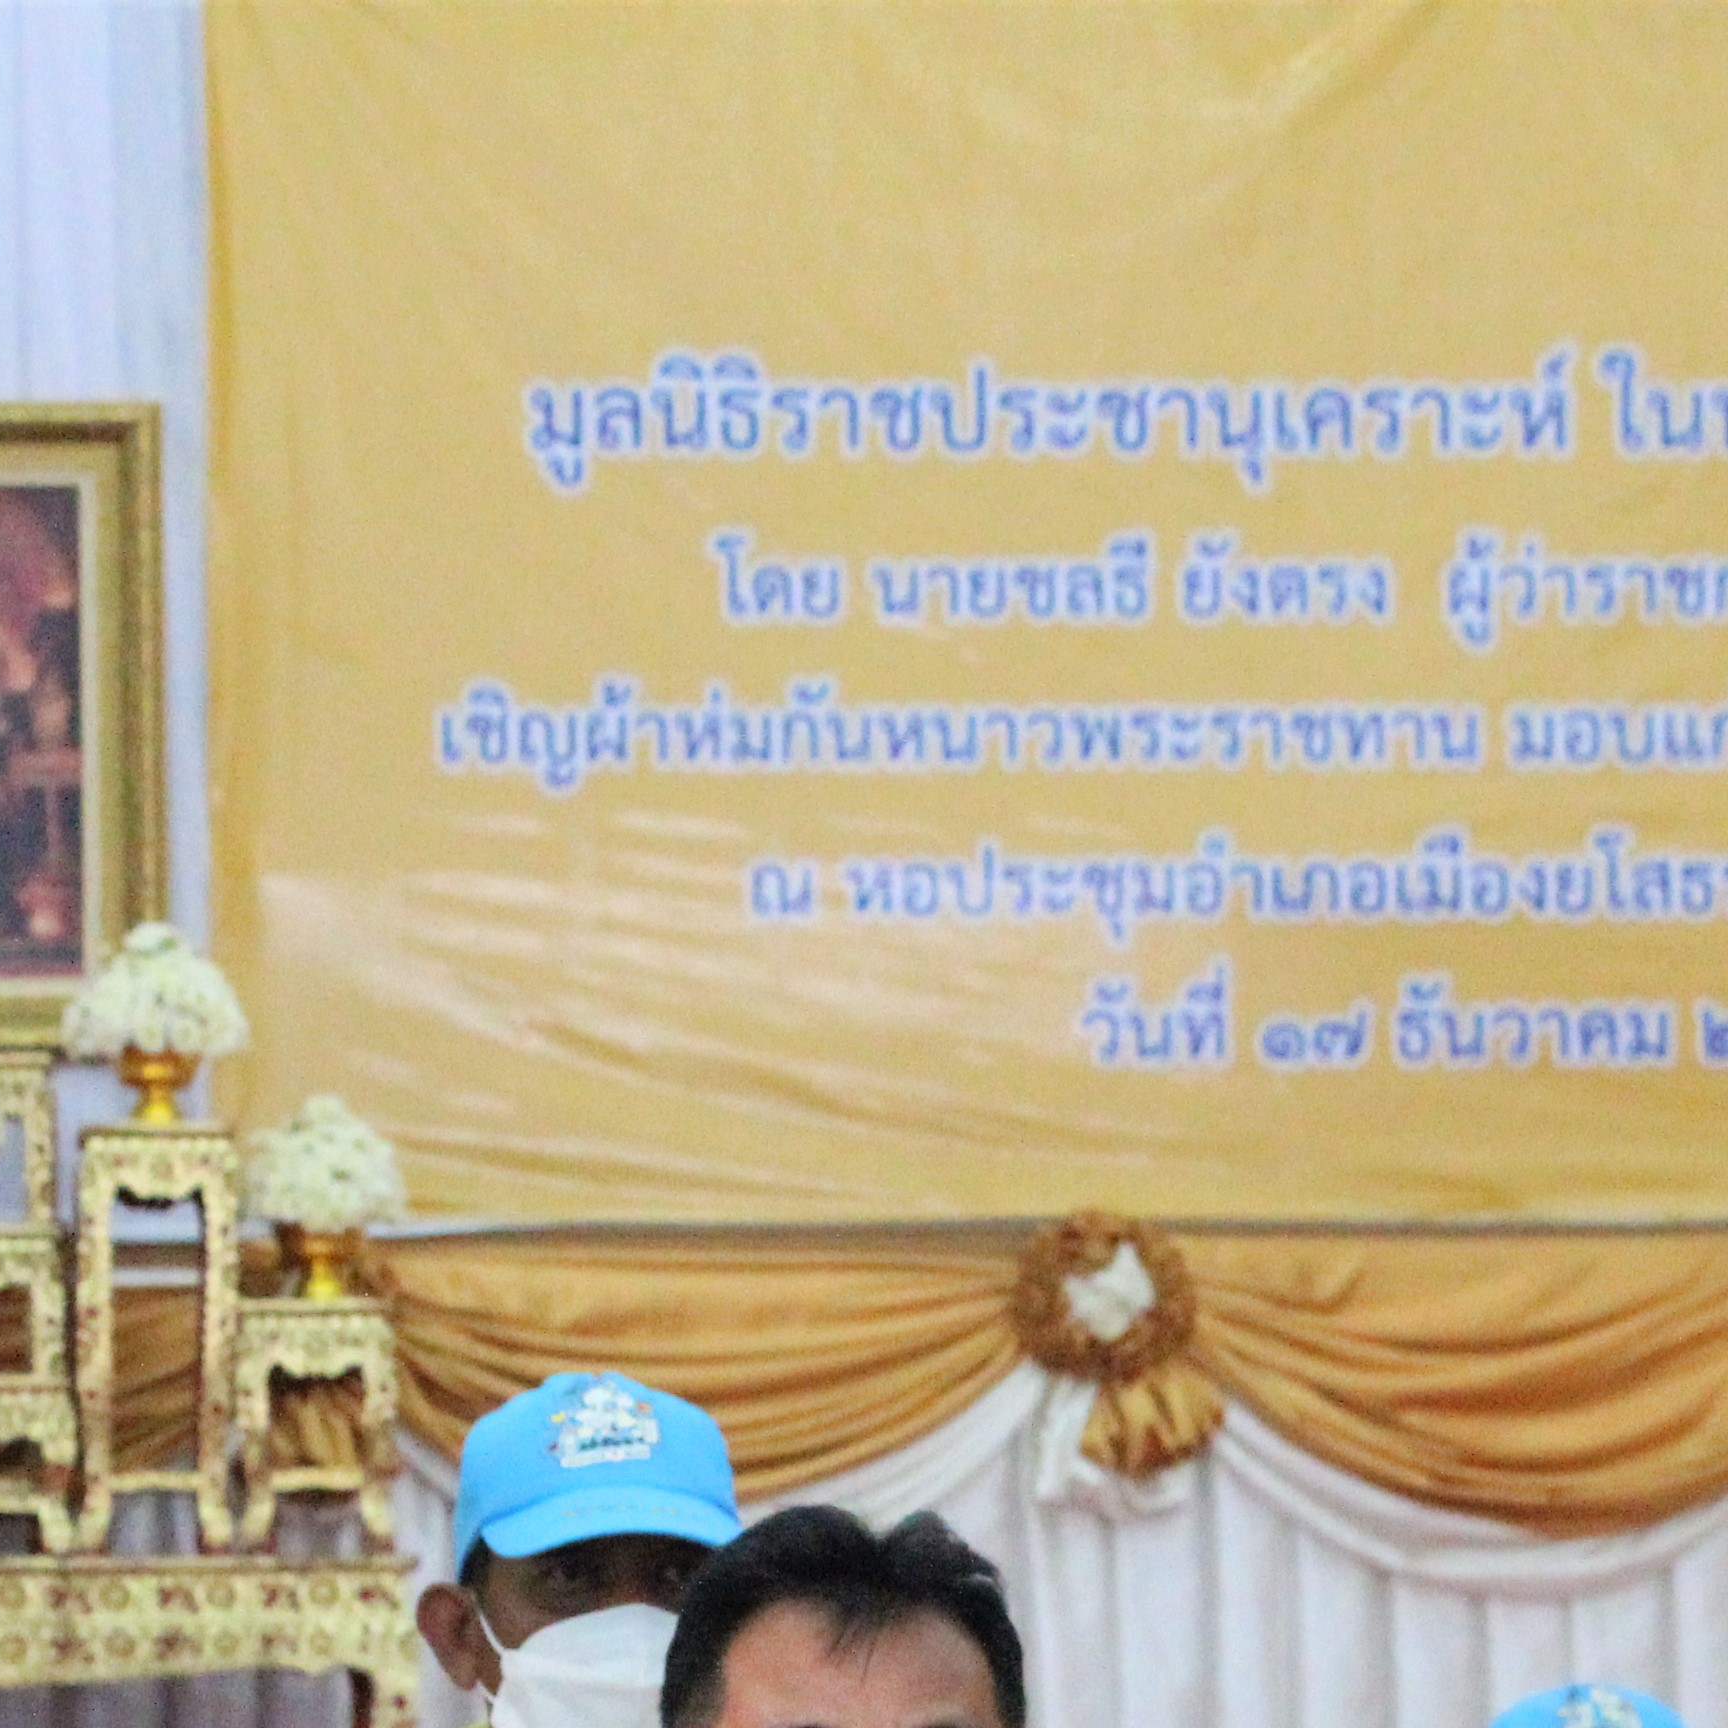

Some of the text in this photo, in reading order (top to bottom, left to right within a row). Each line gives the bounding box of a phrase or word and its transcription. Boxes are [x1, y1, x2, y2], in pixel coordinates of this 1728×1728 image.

[526, 348, 1573, 491] มูลนิธิราชประชานุเคราะห์
[710, 530, 845, 622] โดย
[869, 532, 1154, 622] นายชลธี
[1179, 534, 1392, 621] ยังตรง
[438, 677, 1483, 793] เชิญผ้าห่มกันหนาวพระราชทาน
[747, 859, 818, 922] ณ
[1079, 962, 1230, 1066] วันที่
[1259, 1008, 1371, 1066] ๑๗
[1394, 978, 1673, 1064] ธันวาคม
